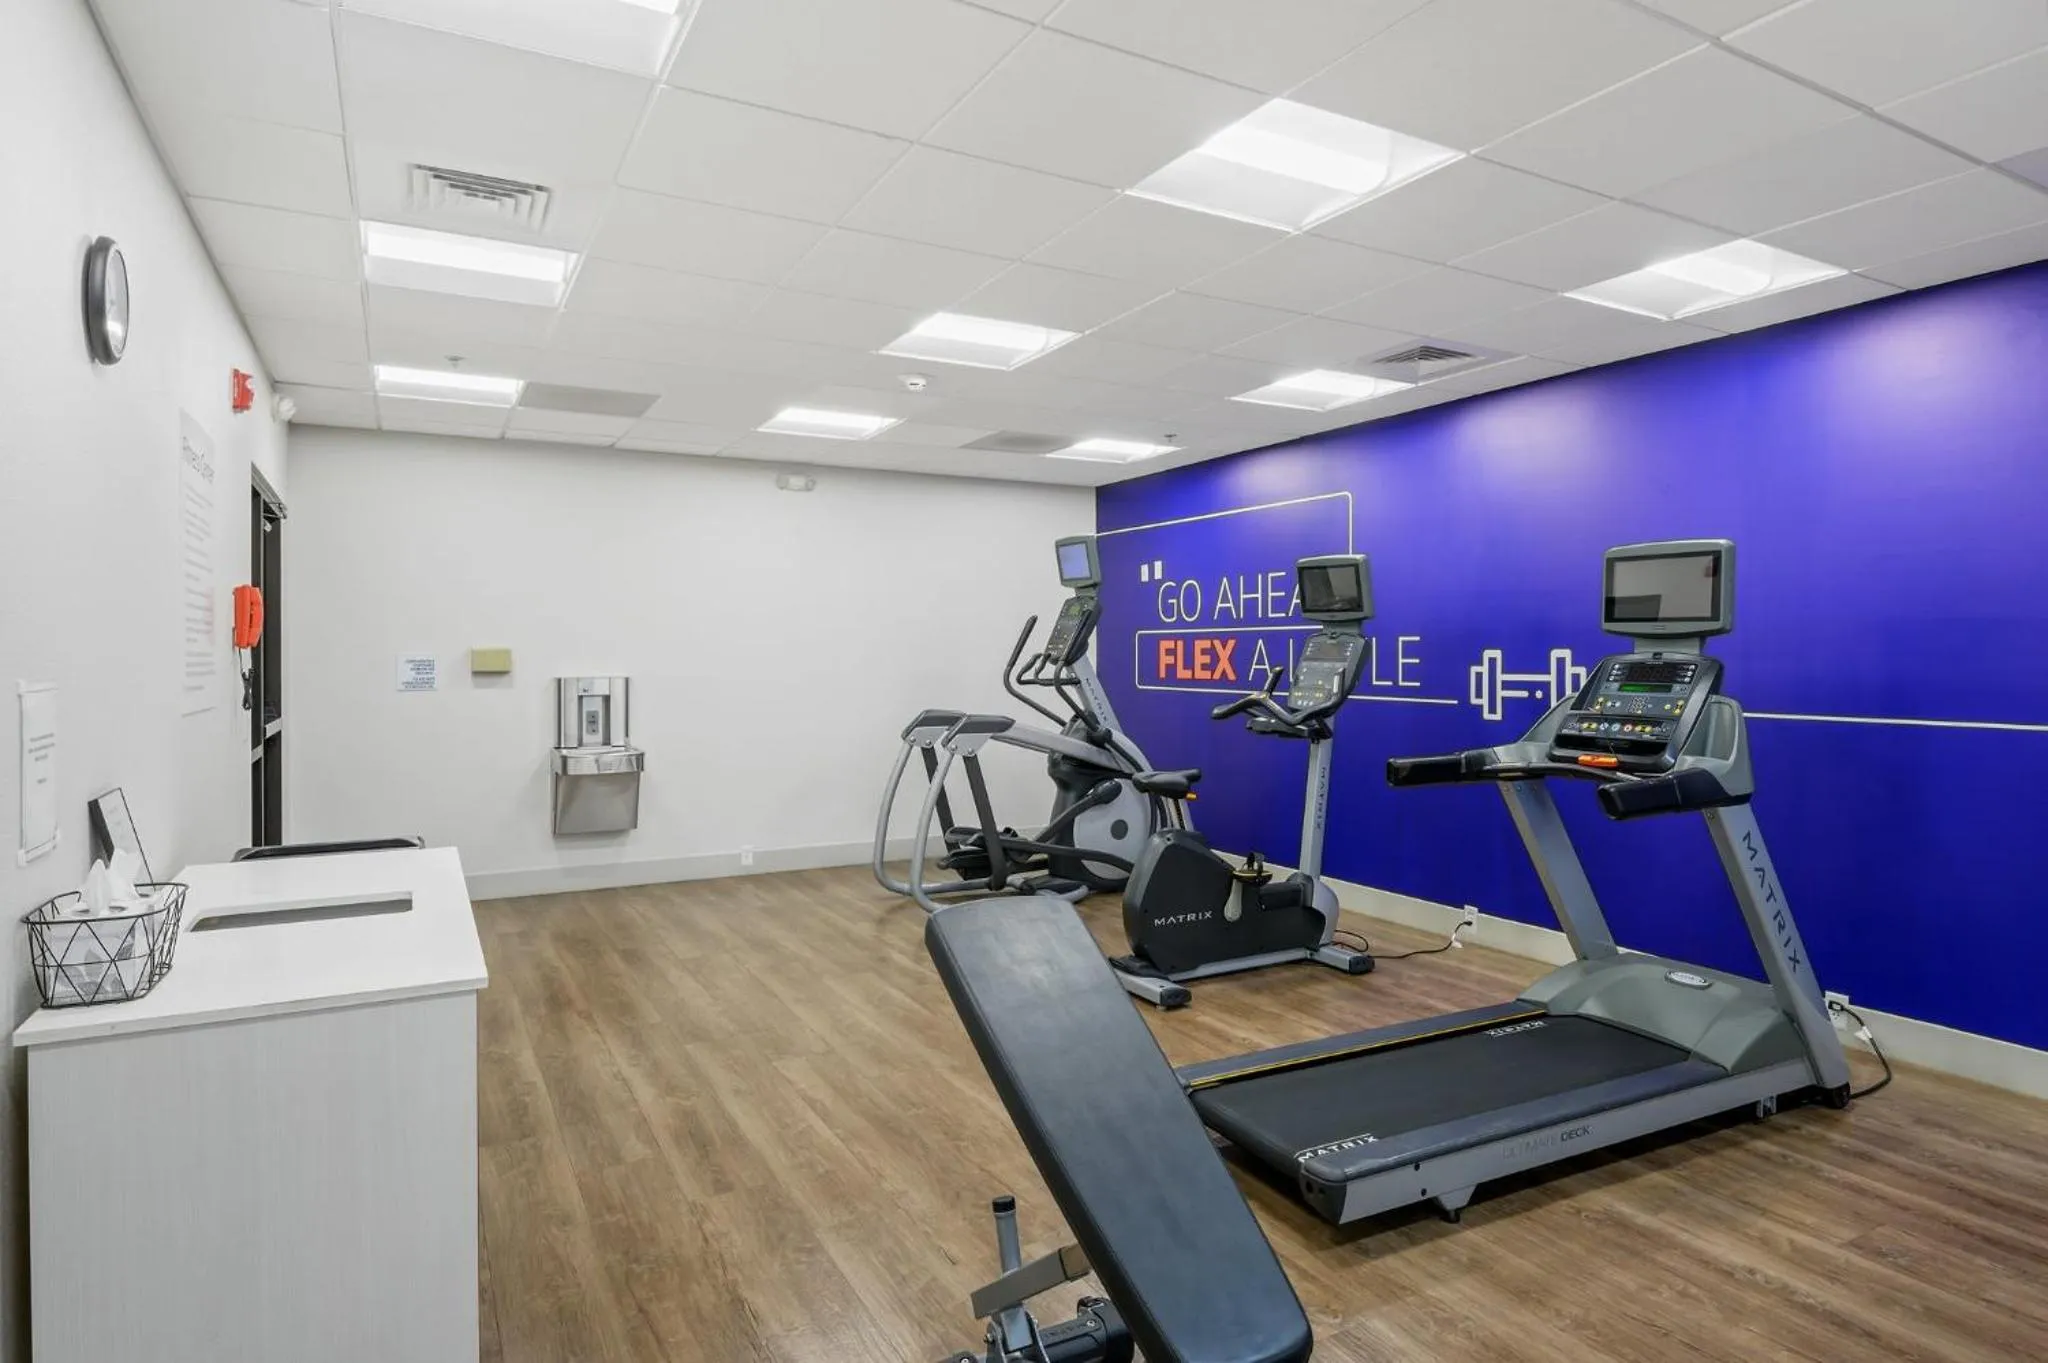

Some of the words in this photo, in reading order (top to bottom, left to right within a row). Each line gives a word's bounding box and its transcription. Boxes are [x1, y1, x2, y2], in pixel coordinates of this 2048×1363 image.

[1158, 638, 1237, 681] FLEX
[1249, 637, 1272, 682] A
[1153, 910, 1213, 927] MATRIX
[1741, 829, 1801, 974] MATRIX
[1297, 1135, 1379, 1163] MATRIX
